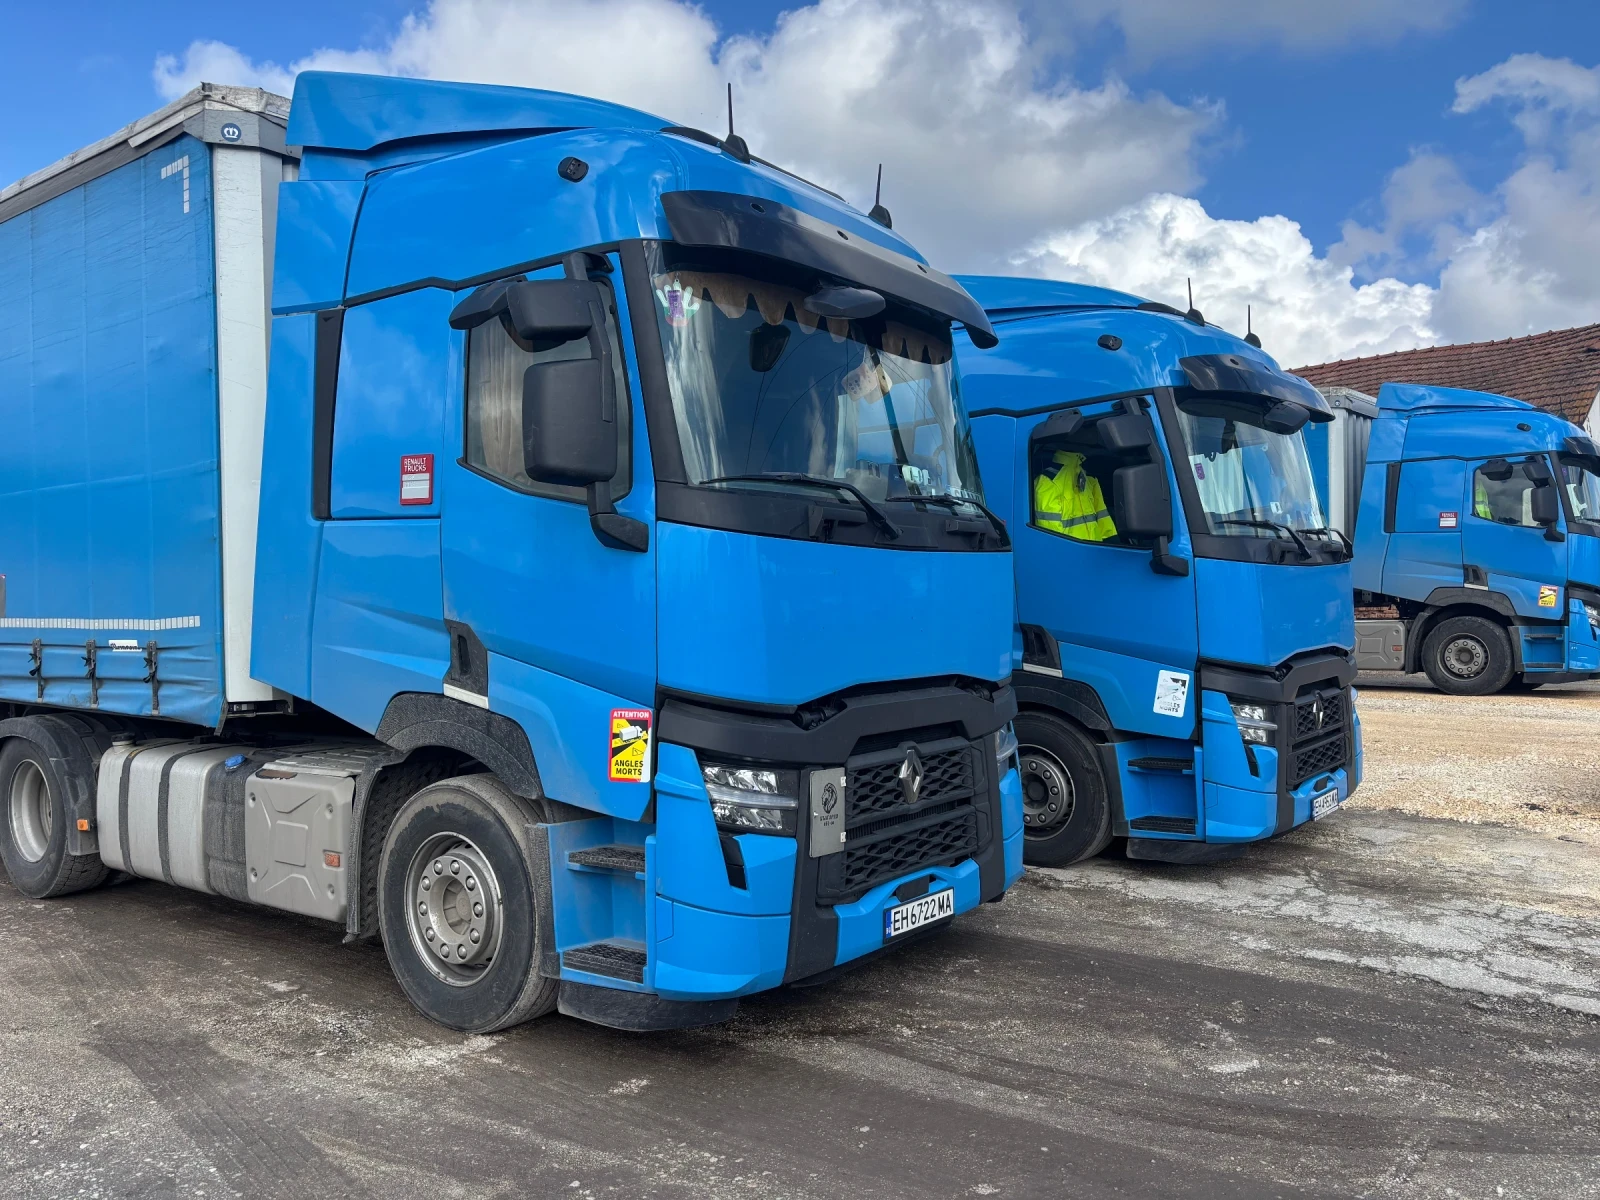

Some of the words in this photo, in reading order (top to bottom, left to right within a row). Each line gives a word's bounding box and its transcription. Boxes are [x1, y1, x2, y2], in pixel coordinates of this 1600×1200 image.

[404, 457, 427, 466] RENAULT
[404, 464, 427, 472] TRUCKS
[613, 711, 649, 719] ATTENTION
[614, 760, 644, 768] ANGLES
[615, 767, 643, 776] MORTS
[893, 907, 909, 933] EH
[910, 898, 937, 926] 6722
[938, 893, 952, 916] MA
